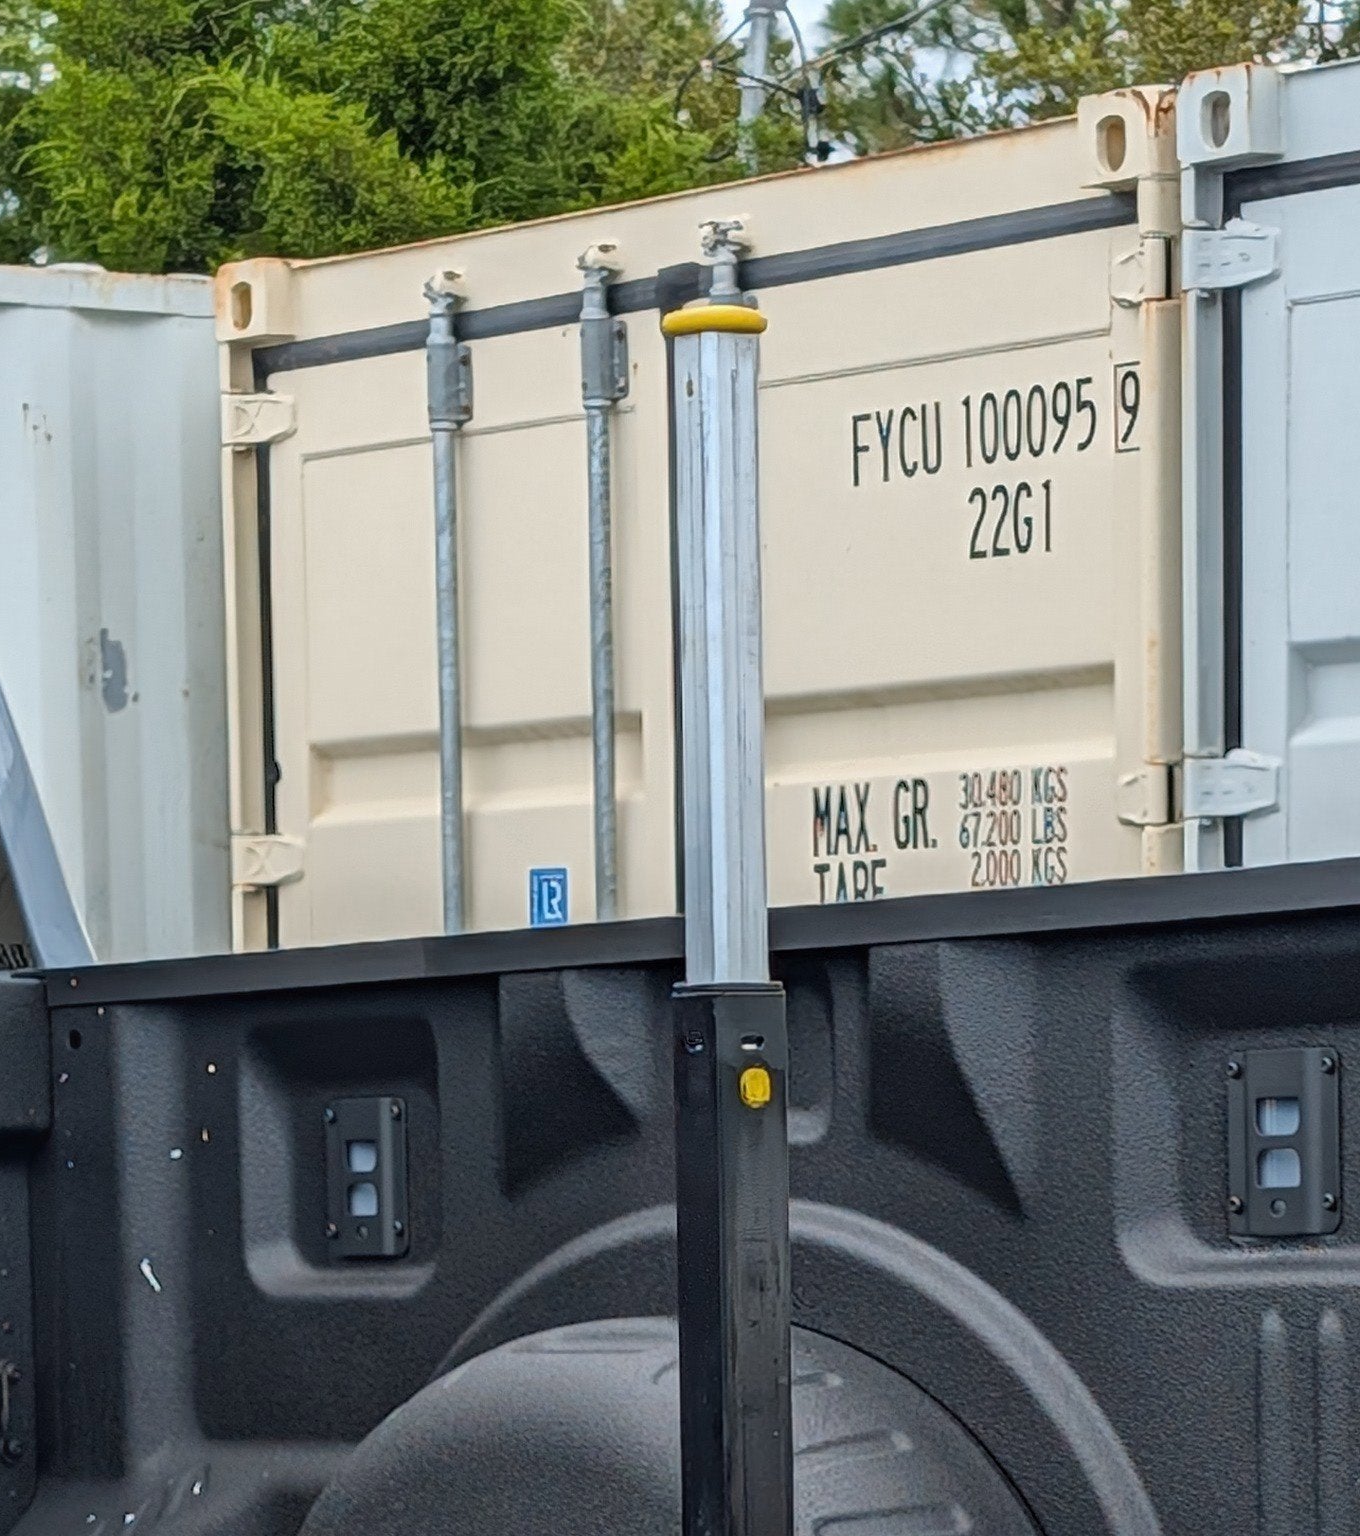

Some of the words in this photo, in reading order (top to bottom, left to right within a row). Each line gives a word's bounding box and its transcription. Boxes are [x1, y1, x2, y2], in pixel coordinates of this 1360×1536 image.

[852, 401, 941, 486] FYCU
[962, 377, 1096, 468] 100095
[1120, 370, 1140, 443] 9
[968, 479, 1051, 559] 22G1
[1031, 766, 1067, 804] KGS
[813, 782, 878, 857] MAX.
[894, 778, 938, 849] GR.
[1031, 806, 1067, 844] LBS
[1031, 846, 1067, 884] KGS
